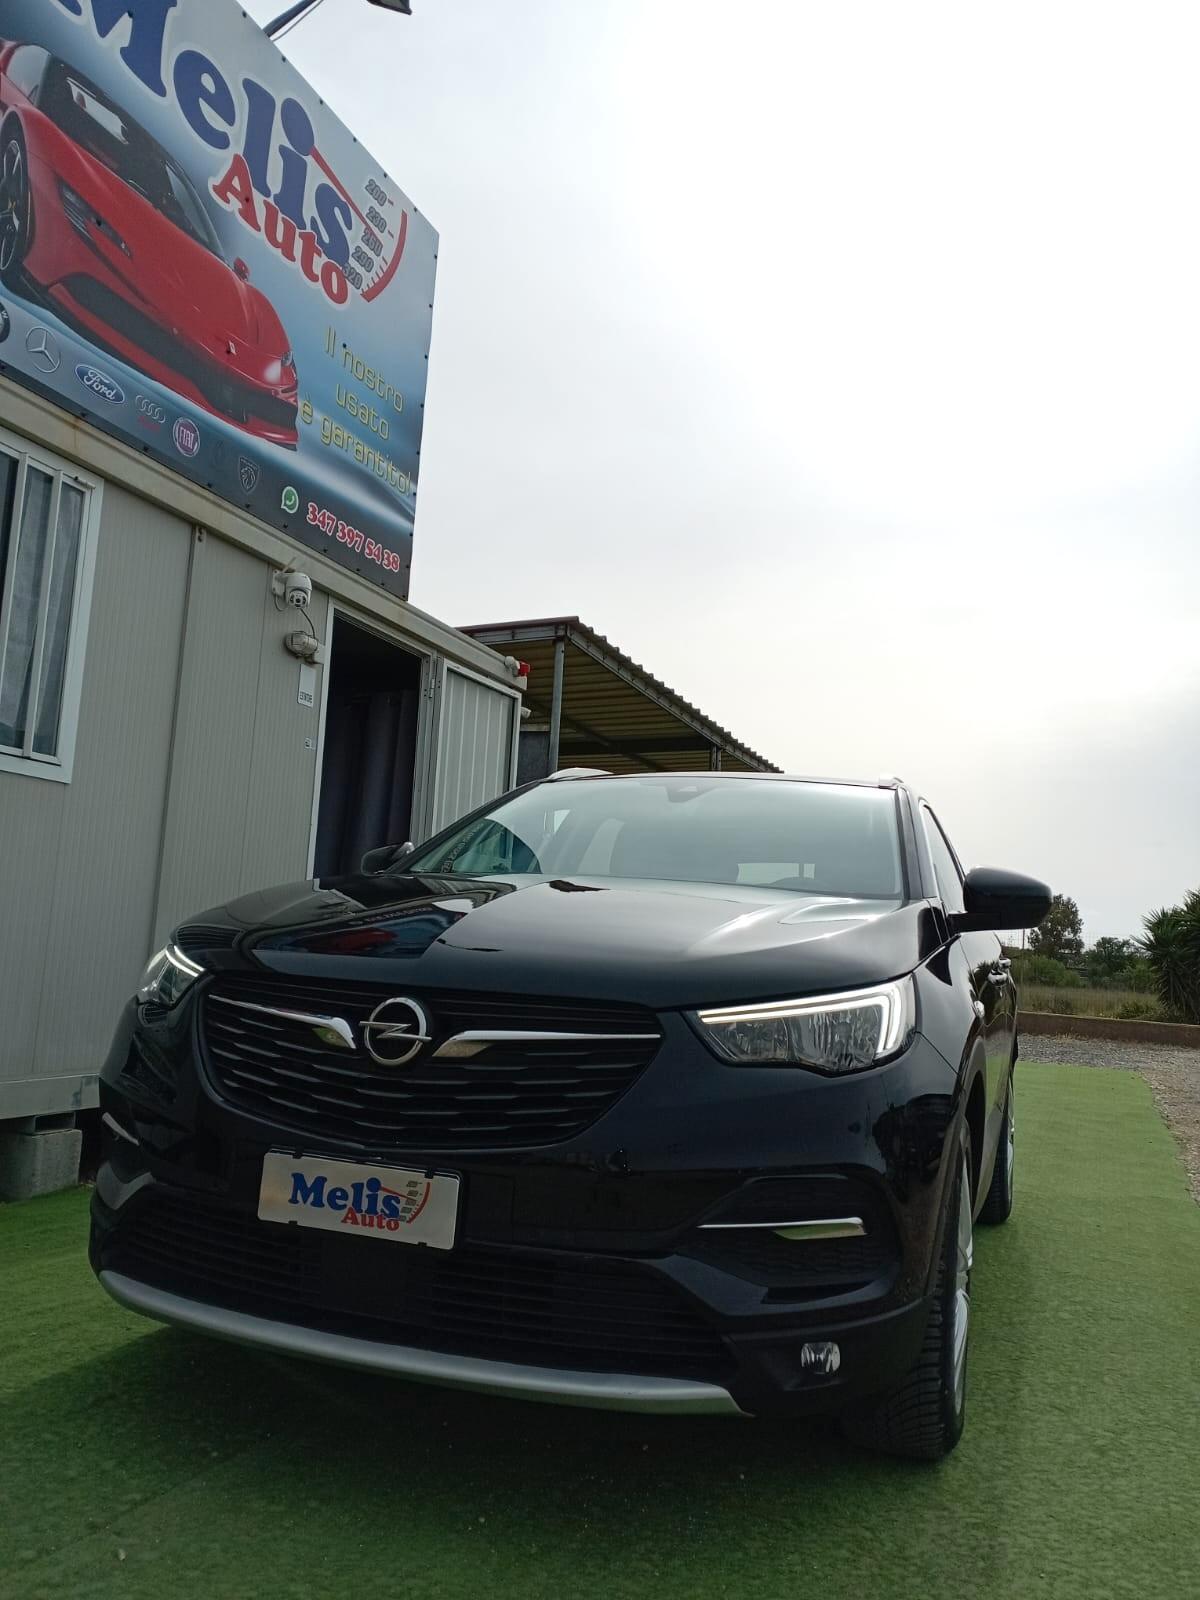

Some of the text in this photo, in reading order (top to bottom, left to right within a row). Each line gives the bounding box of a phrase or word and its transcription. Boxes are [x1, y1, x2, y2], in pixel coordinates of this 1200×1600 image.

[212, 154, 348, 304] Auto
[83, 369, 115, 401] Ford
[342, 347, 403, 413] nostro
[178, 426, 195, 450] FIAT
[336, 384, 389, 440] usato
[320, 415, 411, 496] garantito!
[307, 502, 400, 572] 347 397 54 38
[288, 1173, 400, 1218] Melis
[341, 1207, 399, 1231] Auto
